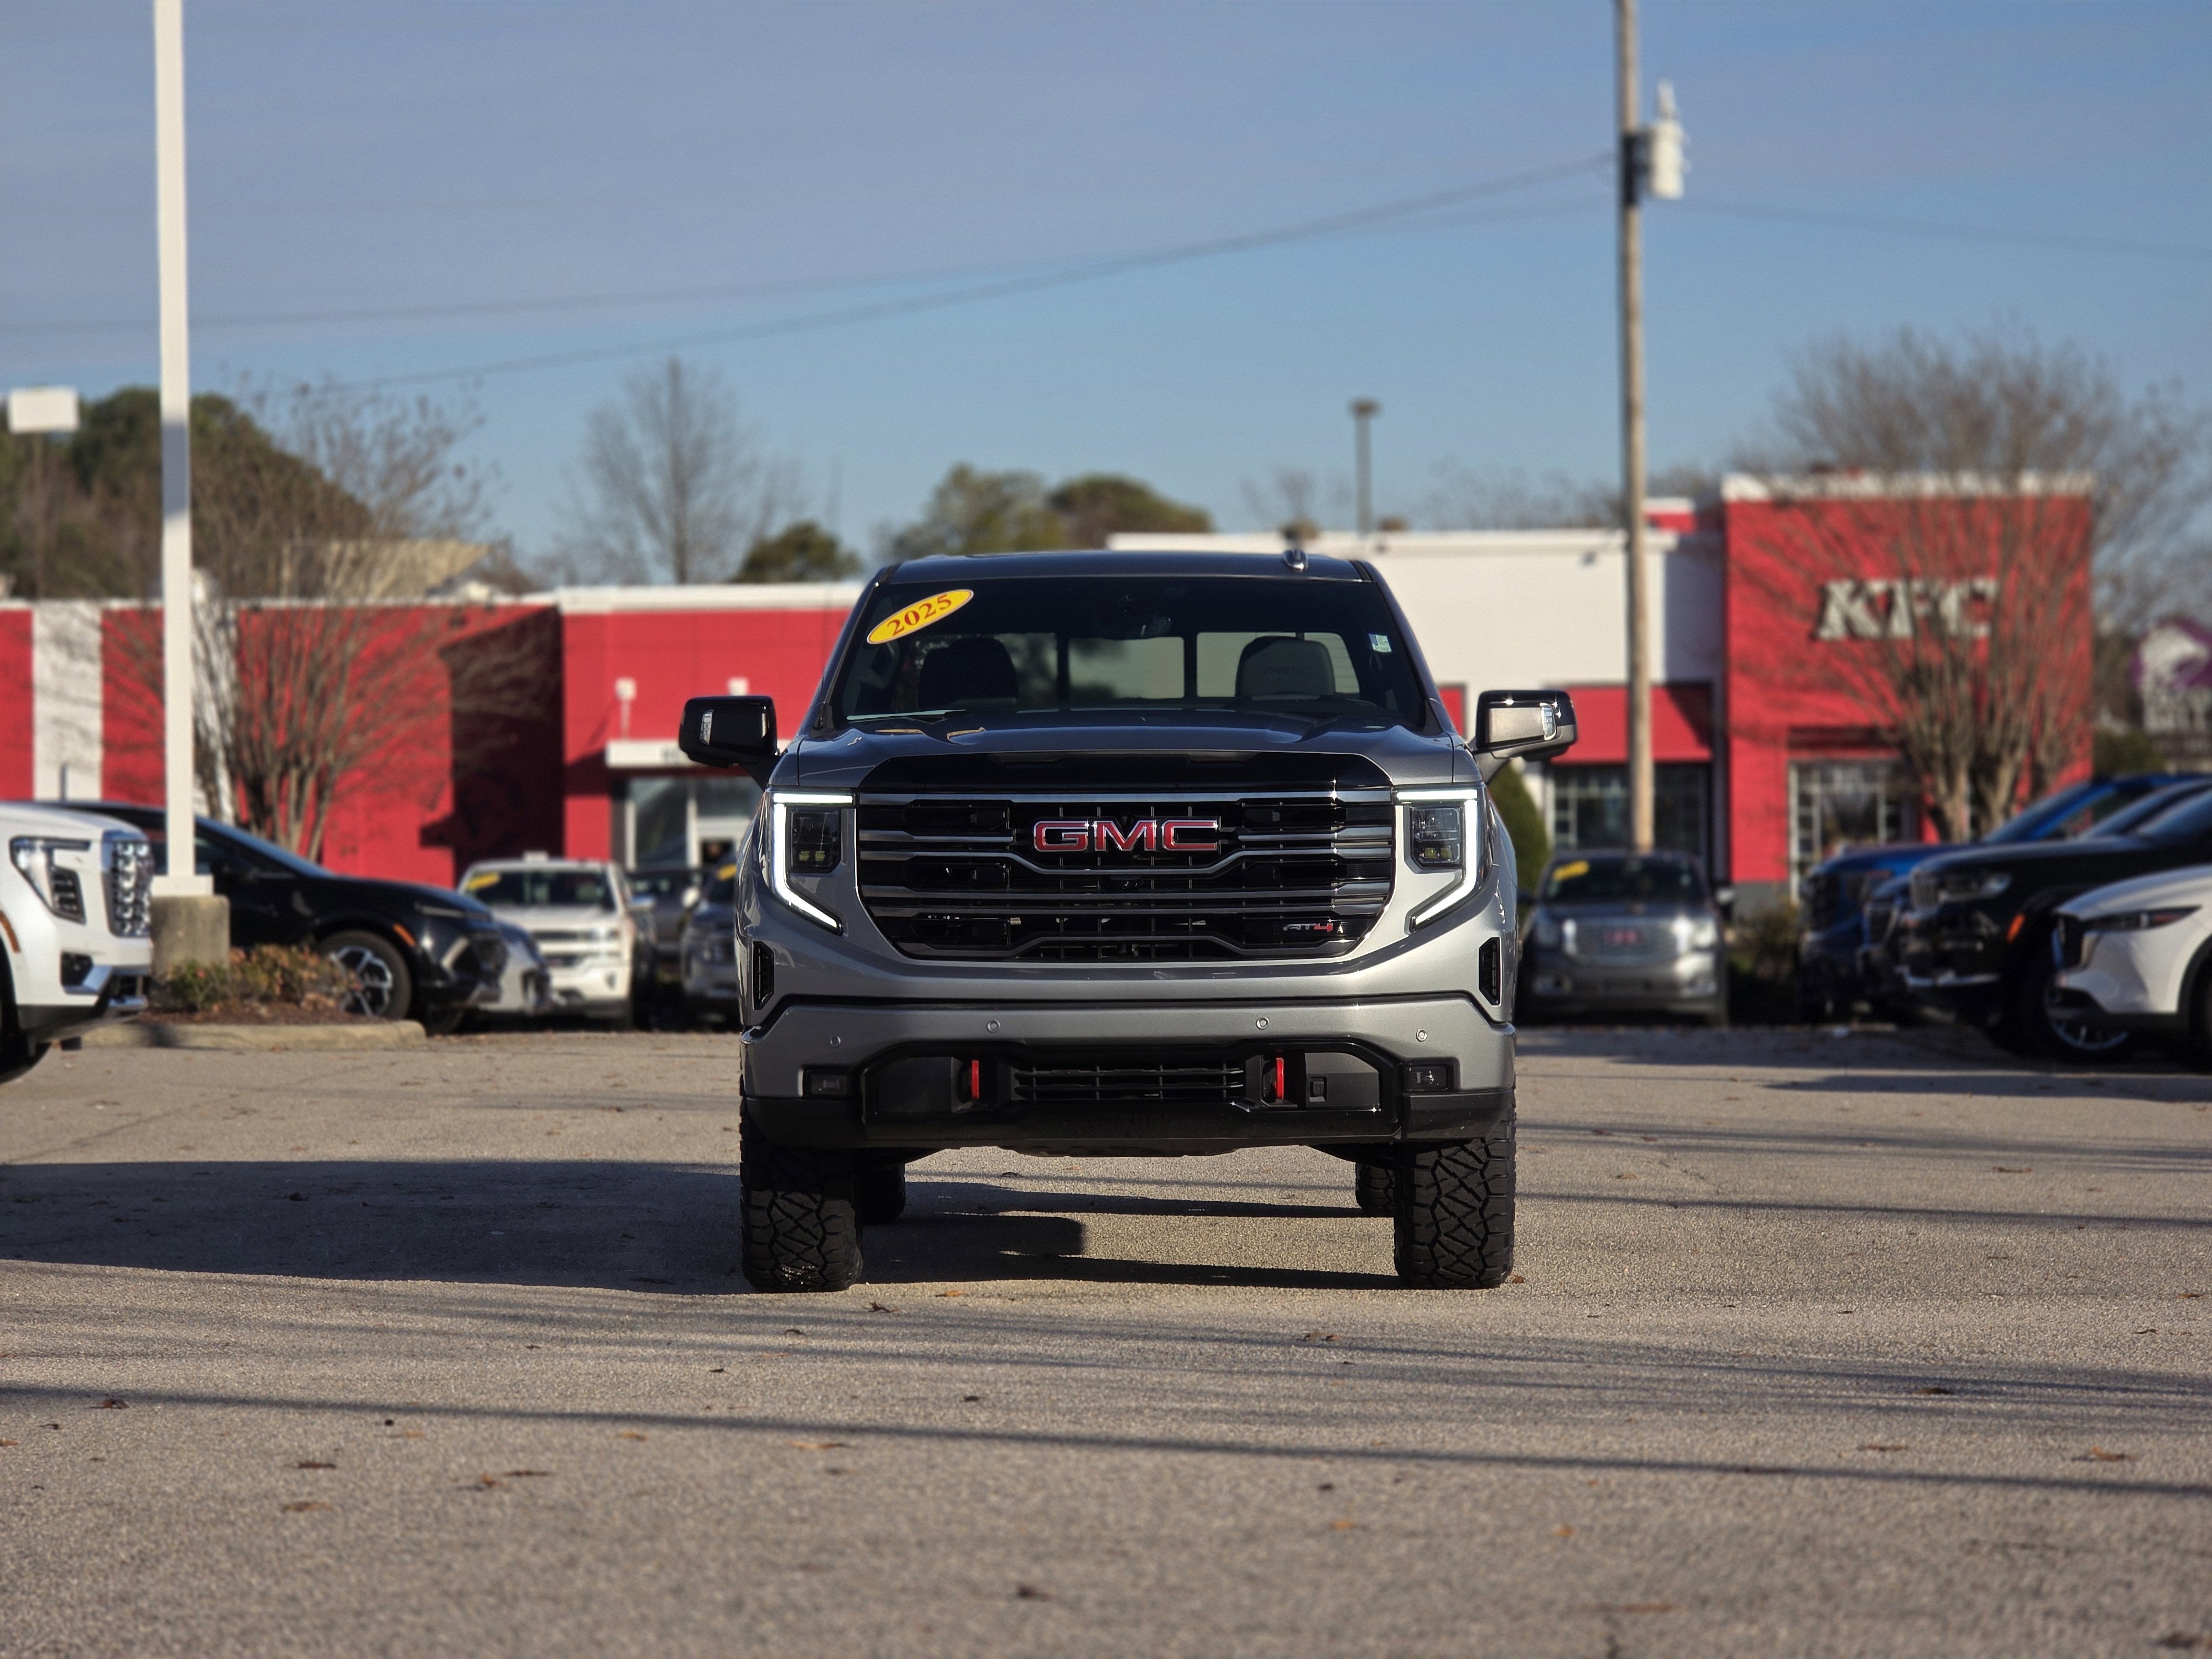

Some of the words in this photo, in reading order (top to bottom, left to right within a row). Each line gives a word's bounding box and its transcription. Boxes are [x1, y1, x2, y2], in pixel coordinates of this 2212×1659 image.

[886, 593, 952, 637] 2025
[1817, 577, 1997, 640] KFC
[1033, 820, 1218, 852] GMC
[1283, 922, 1333, 932] AT4
